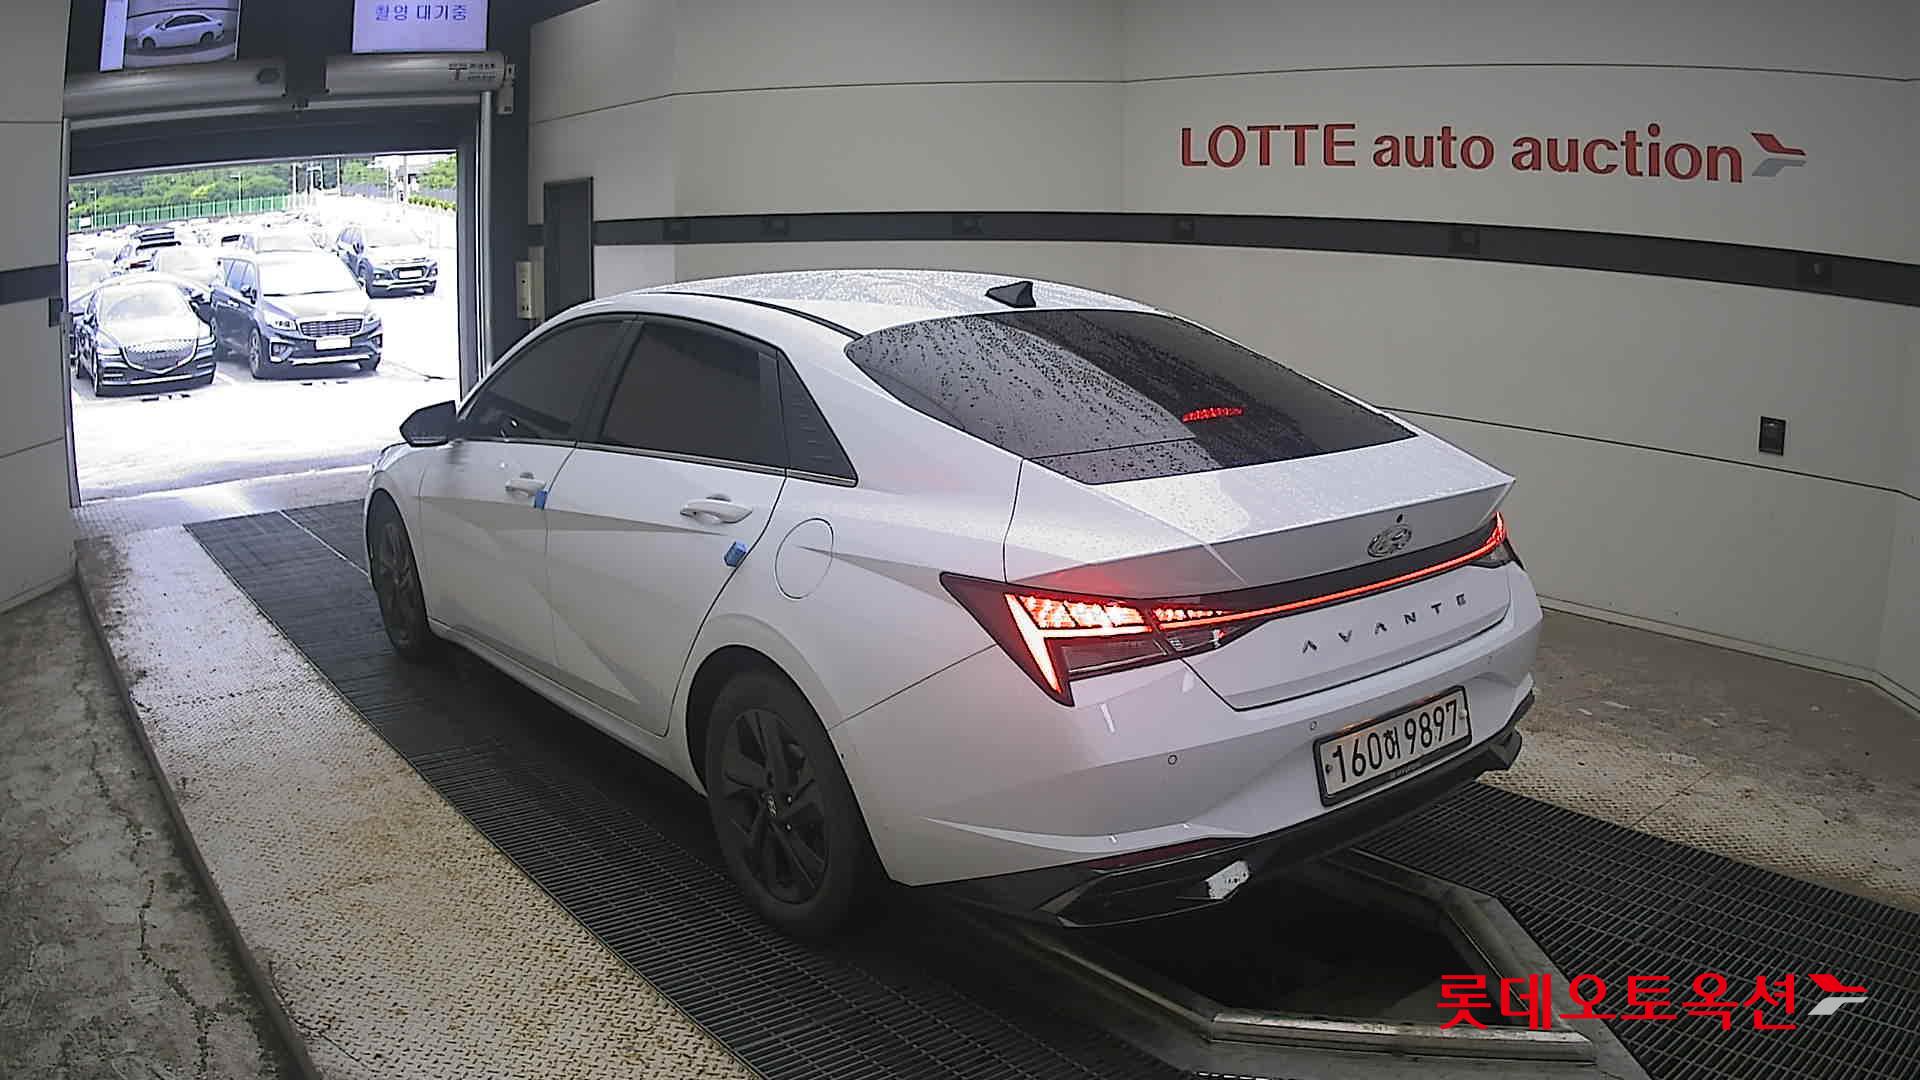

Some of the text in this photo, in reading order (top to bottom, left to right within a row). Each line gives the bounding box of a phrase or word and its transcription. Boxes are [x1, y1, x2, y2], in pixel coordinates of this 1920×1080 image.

[416, 4, 467, 21] 대기중
[1181, 123, 1743, 183] LOTTE auto auction
[1302, 593, 1467, 654] AVANTE
